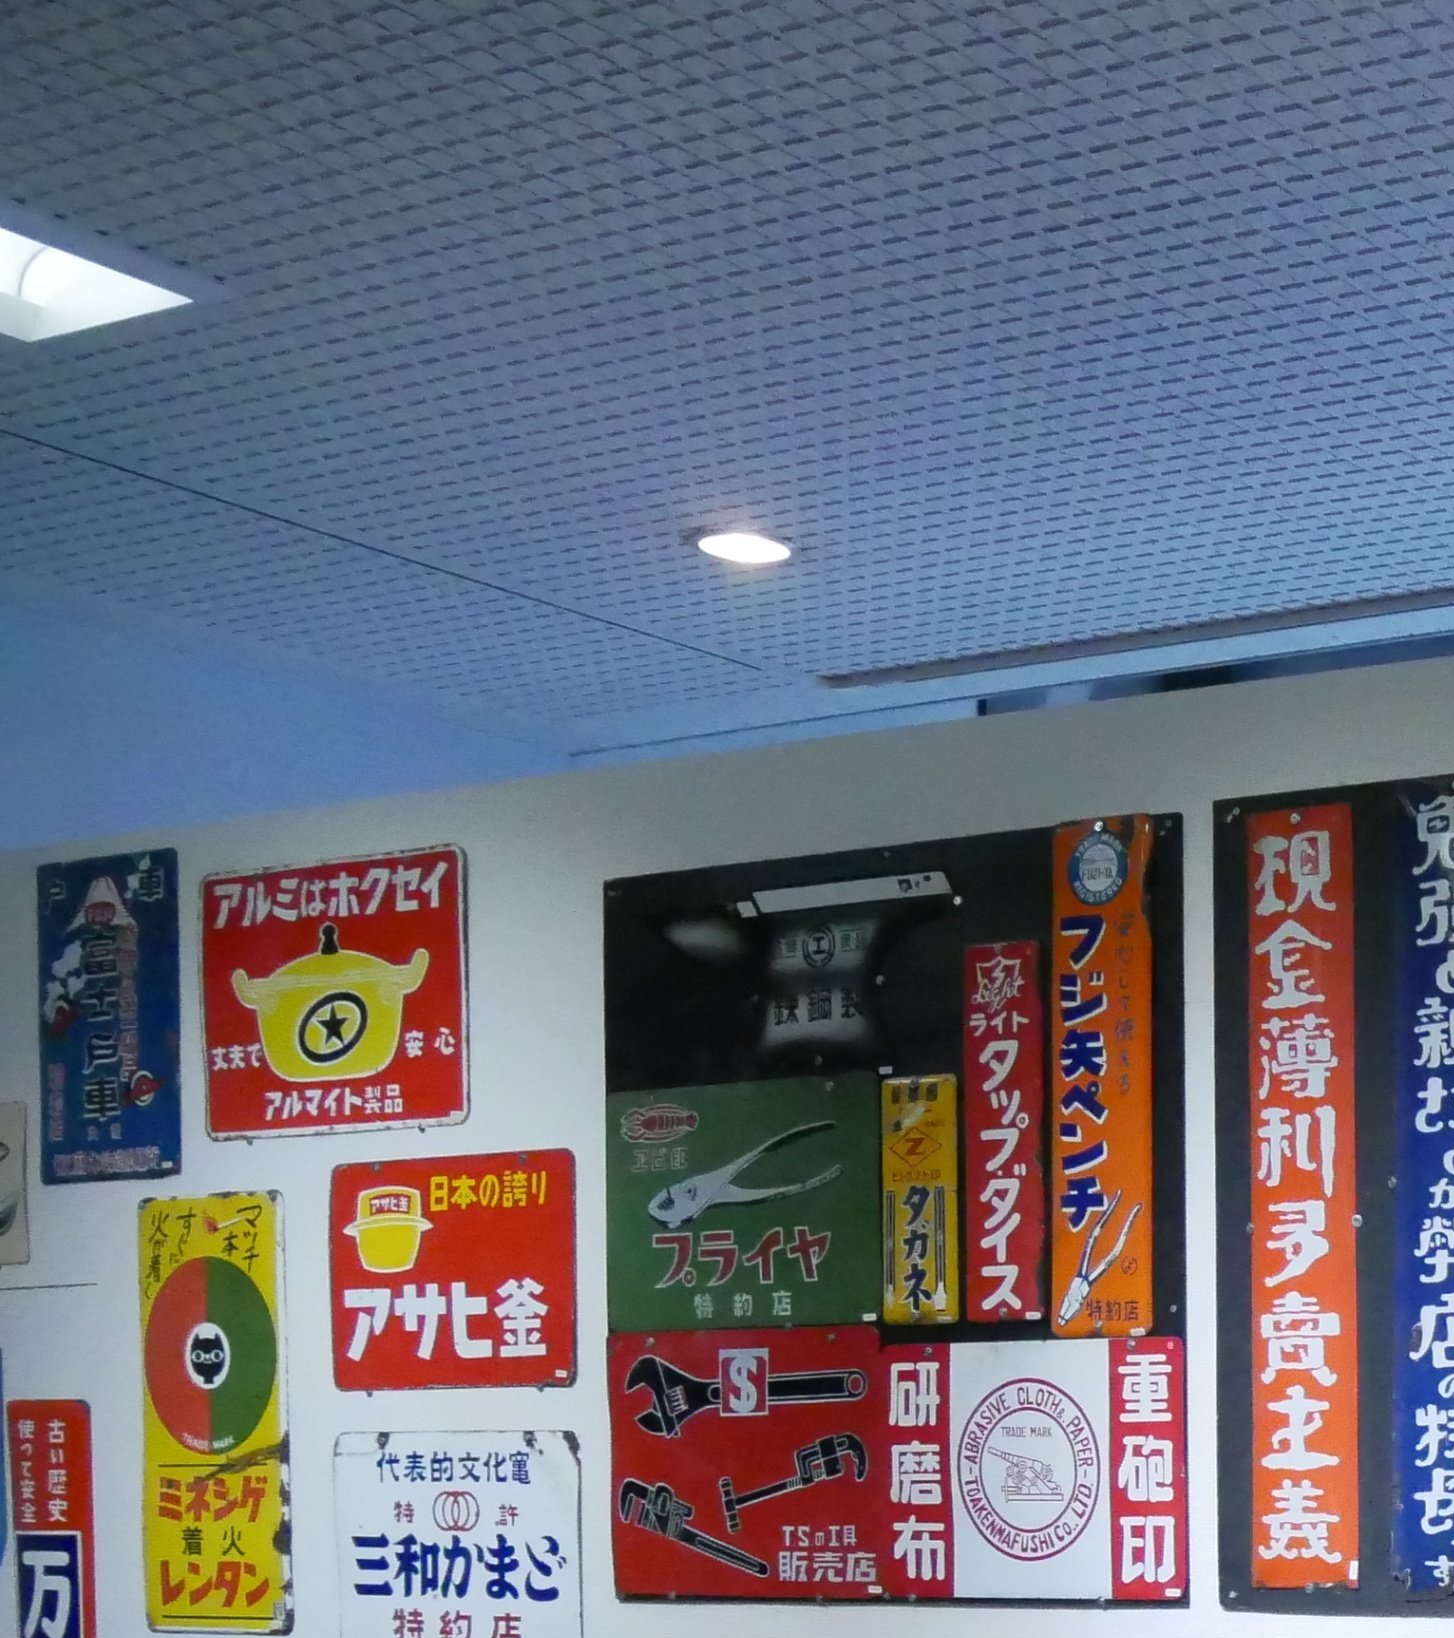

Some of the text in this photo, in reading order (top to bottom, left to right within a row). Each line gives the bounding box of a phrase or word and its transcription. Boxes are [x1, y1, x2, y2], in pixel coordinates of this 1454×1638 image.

[213, 861, 448, 928] アルミはホクセイ
[212, 1043, 263, 1071] 丈夫で
[404, 1027, 455, 1058] 安心
[969, 1013, 1030, 1038] ライト
[265, 1084, 403, 1120] アルマイト製品
[1058, 914, 1108, 1232] フジ矢ペンチ
[430, 1171, 547, 1212] 日本の誇り
[978, 1040, 1027, 1310] タップダイス
[652, 1226, 830, 1290] プライヤ
[901, 1185, 932, 1310] タガネ
[342, 1278, 549, 1361] アサヒ釜
[692, 1292, 793, 1320] 特約店
[1087, 1297, 1140, 1322] 特約店
[964, 1387, 1094, 1467] ABRASIVE CLOTH PAPER
[1000, 1426, 1053, 1438] TRADE MARK
[17, 1418, 37, 1523] 使って安全
[47, 1418, 68, 1525] 古い歴史
[889, 1361, 947, 1581] 研磨布
[1118, 1354, 1176, 1585] 重砲印
[180, 1526, 243, 1556] 着火
[965, 1475, 1054, 1553] TOAKENMAFUSHI
[160, 1559, 270, 1607] レンタン
[351, 1532, 567, 1602] 三和かまど
[779, 1550, 878, 1582] 販売店
